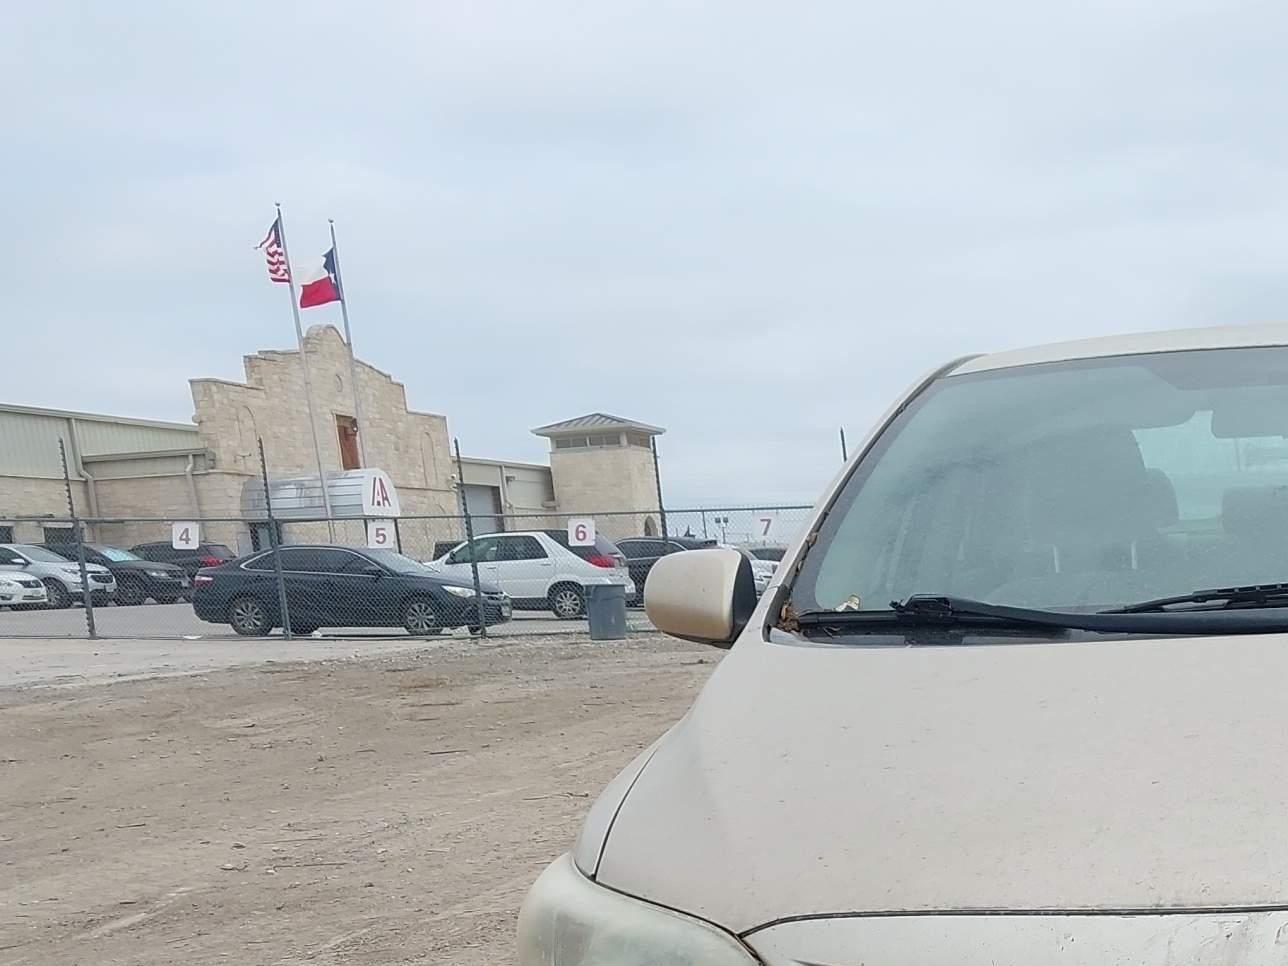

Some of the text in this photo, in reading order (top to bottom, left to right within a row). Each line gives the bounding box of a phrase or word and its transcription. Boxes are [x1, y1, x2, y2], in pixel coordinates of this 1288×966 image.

[178, 527, 192, 545] 4
[375, 527, 387, 545] 5
[575, 523, 588, 541] 6
[760, 518, 772, 536] 7
